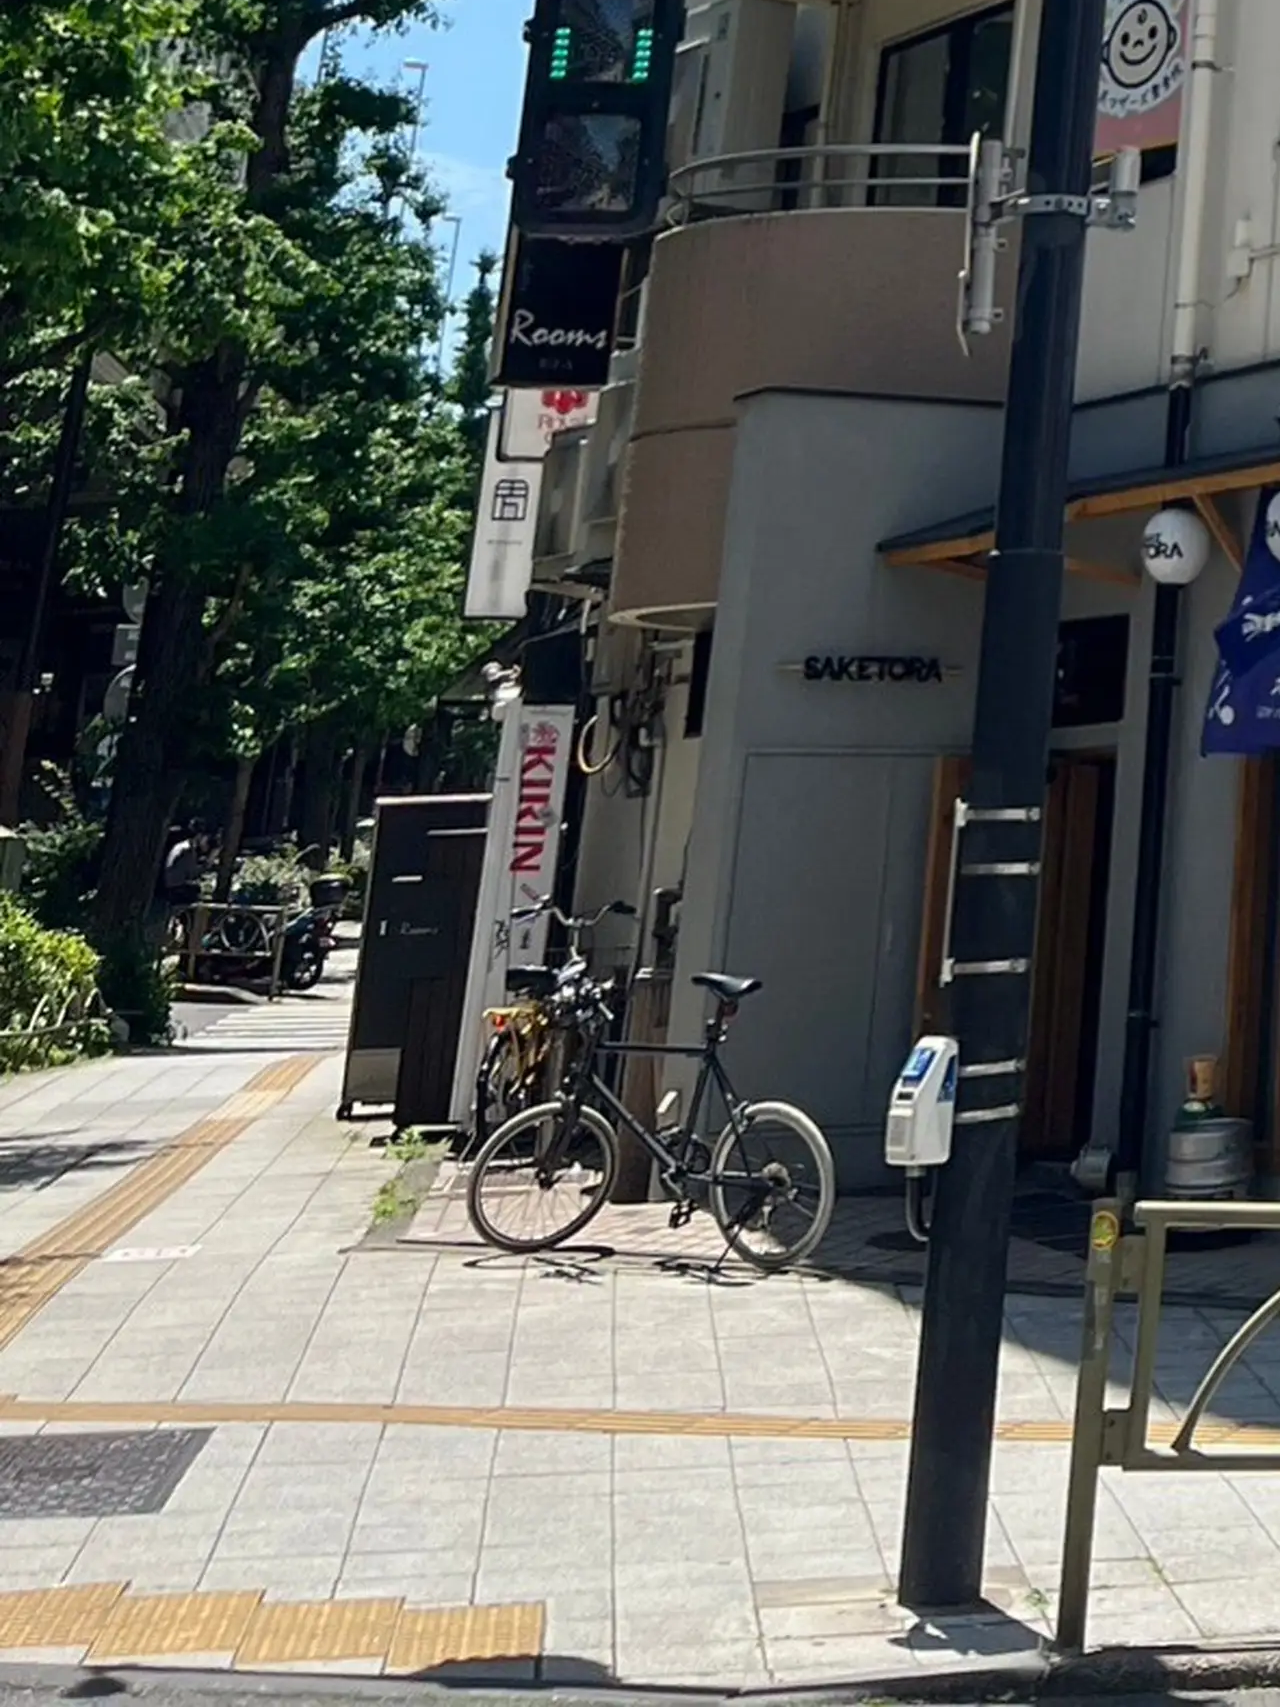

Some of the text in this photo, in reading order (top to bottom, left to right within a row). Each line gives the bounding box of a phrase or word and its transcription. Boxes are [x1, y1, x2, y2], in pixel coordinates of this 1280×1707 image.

[509, 308, 608, 350] Rooms
[1145, 541, 1185, 561] ORA
[803, 655, 943, 684] SAKETORA
[509, 743, 557, 875] KIRIN
